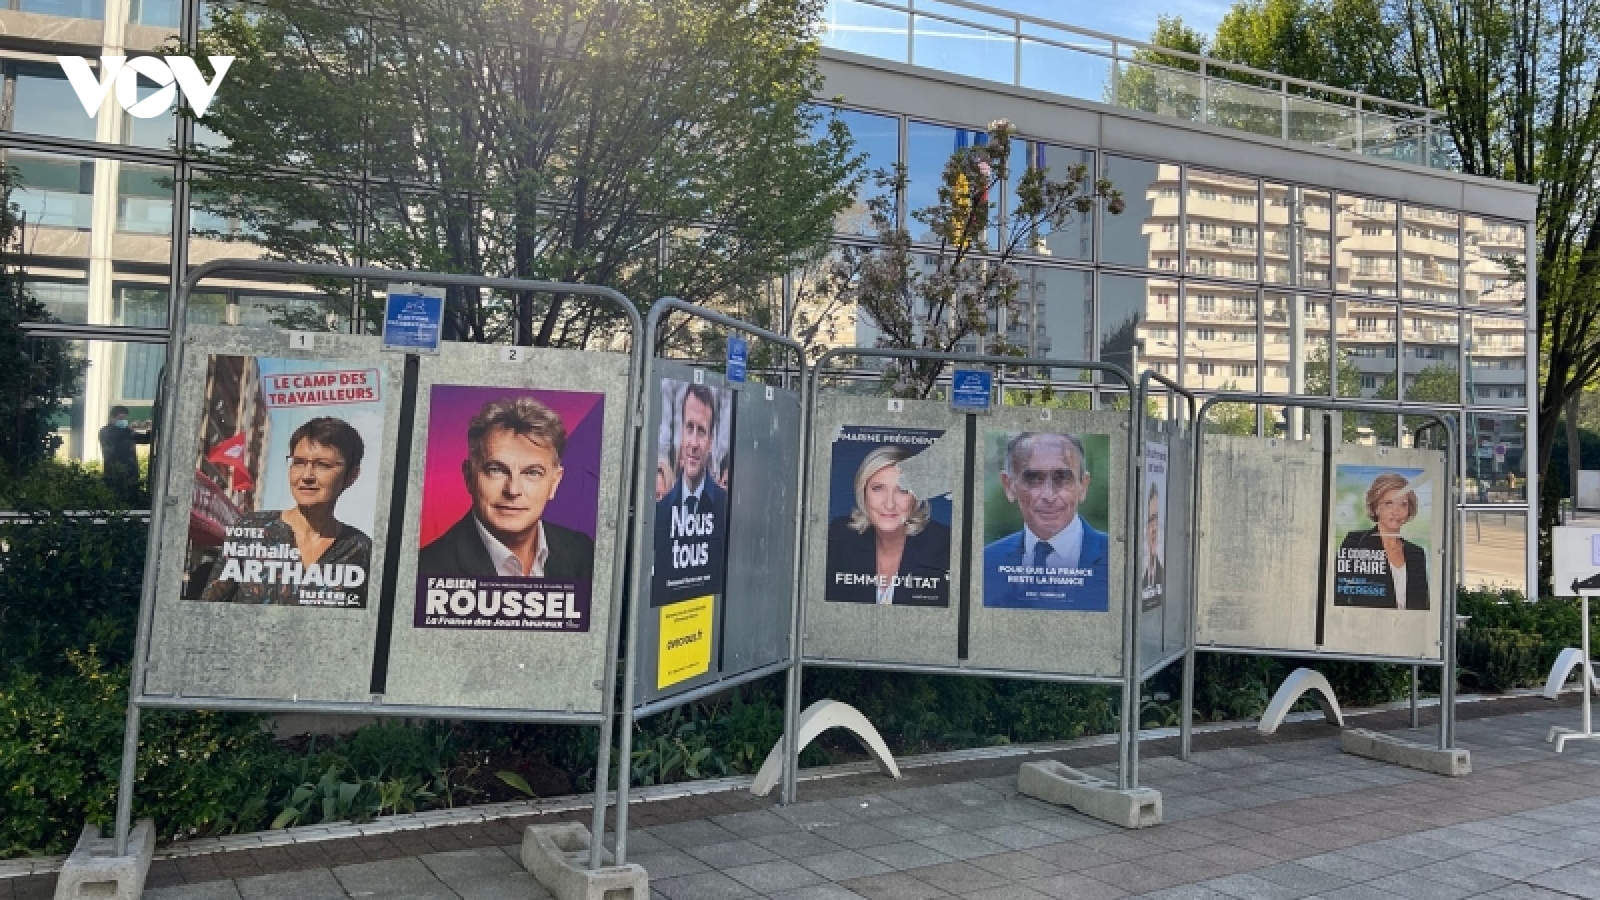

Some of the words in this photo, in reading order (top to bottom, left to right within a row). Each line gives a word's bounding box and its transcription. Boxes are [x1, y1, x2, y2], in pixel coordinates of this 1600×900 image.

[300, 335, 306, 346] 1
[508, 349, 517, 361] 2
[273, 377, 290, 389] LE
[293, 375, 337, 388] CAMP
[340, 373, 367, 384] DES
[268, 388, 373, 405] TRAVAILLEURS
[670, 506, 715, 538] Nous
[225, 527, 265, 539] VOTEZ
[223, 542, 301, 559] Nathalie
[672, 540, 709, 569] tous
[1337, 548, 1347, 559] LE
[1348, 548, 1386, 561] COURAGE
[219, 559, 366, 588] ARTHAUD
[998, 566, 1024, 574] POUR
[1046, 567, 1056, 575] LA
[1057, 568, 1094, 577] FRANCE
[1337, 559, 1352, 573] DE
[1353, 561, 1387, 575] FAIRE
[428, 577, 476, 589] FABIEN
[835, 572, 889, 587] FEMME
[891, 573, 940, 589] D'ÉTAT
[1036, 576, 1047, 584] LA
[1049, 577, 1084, 586] FRANCE
[425, 589, 581, 619] ROUSSEL
[438, 617, 472, 627] France
[474, 618, 491, 627] des
[522, 619, 563, 629] heureux
